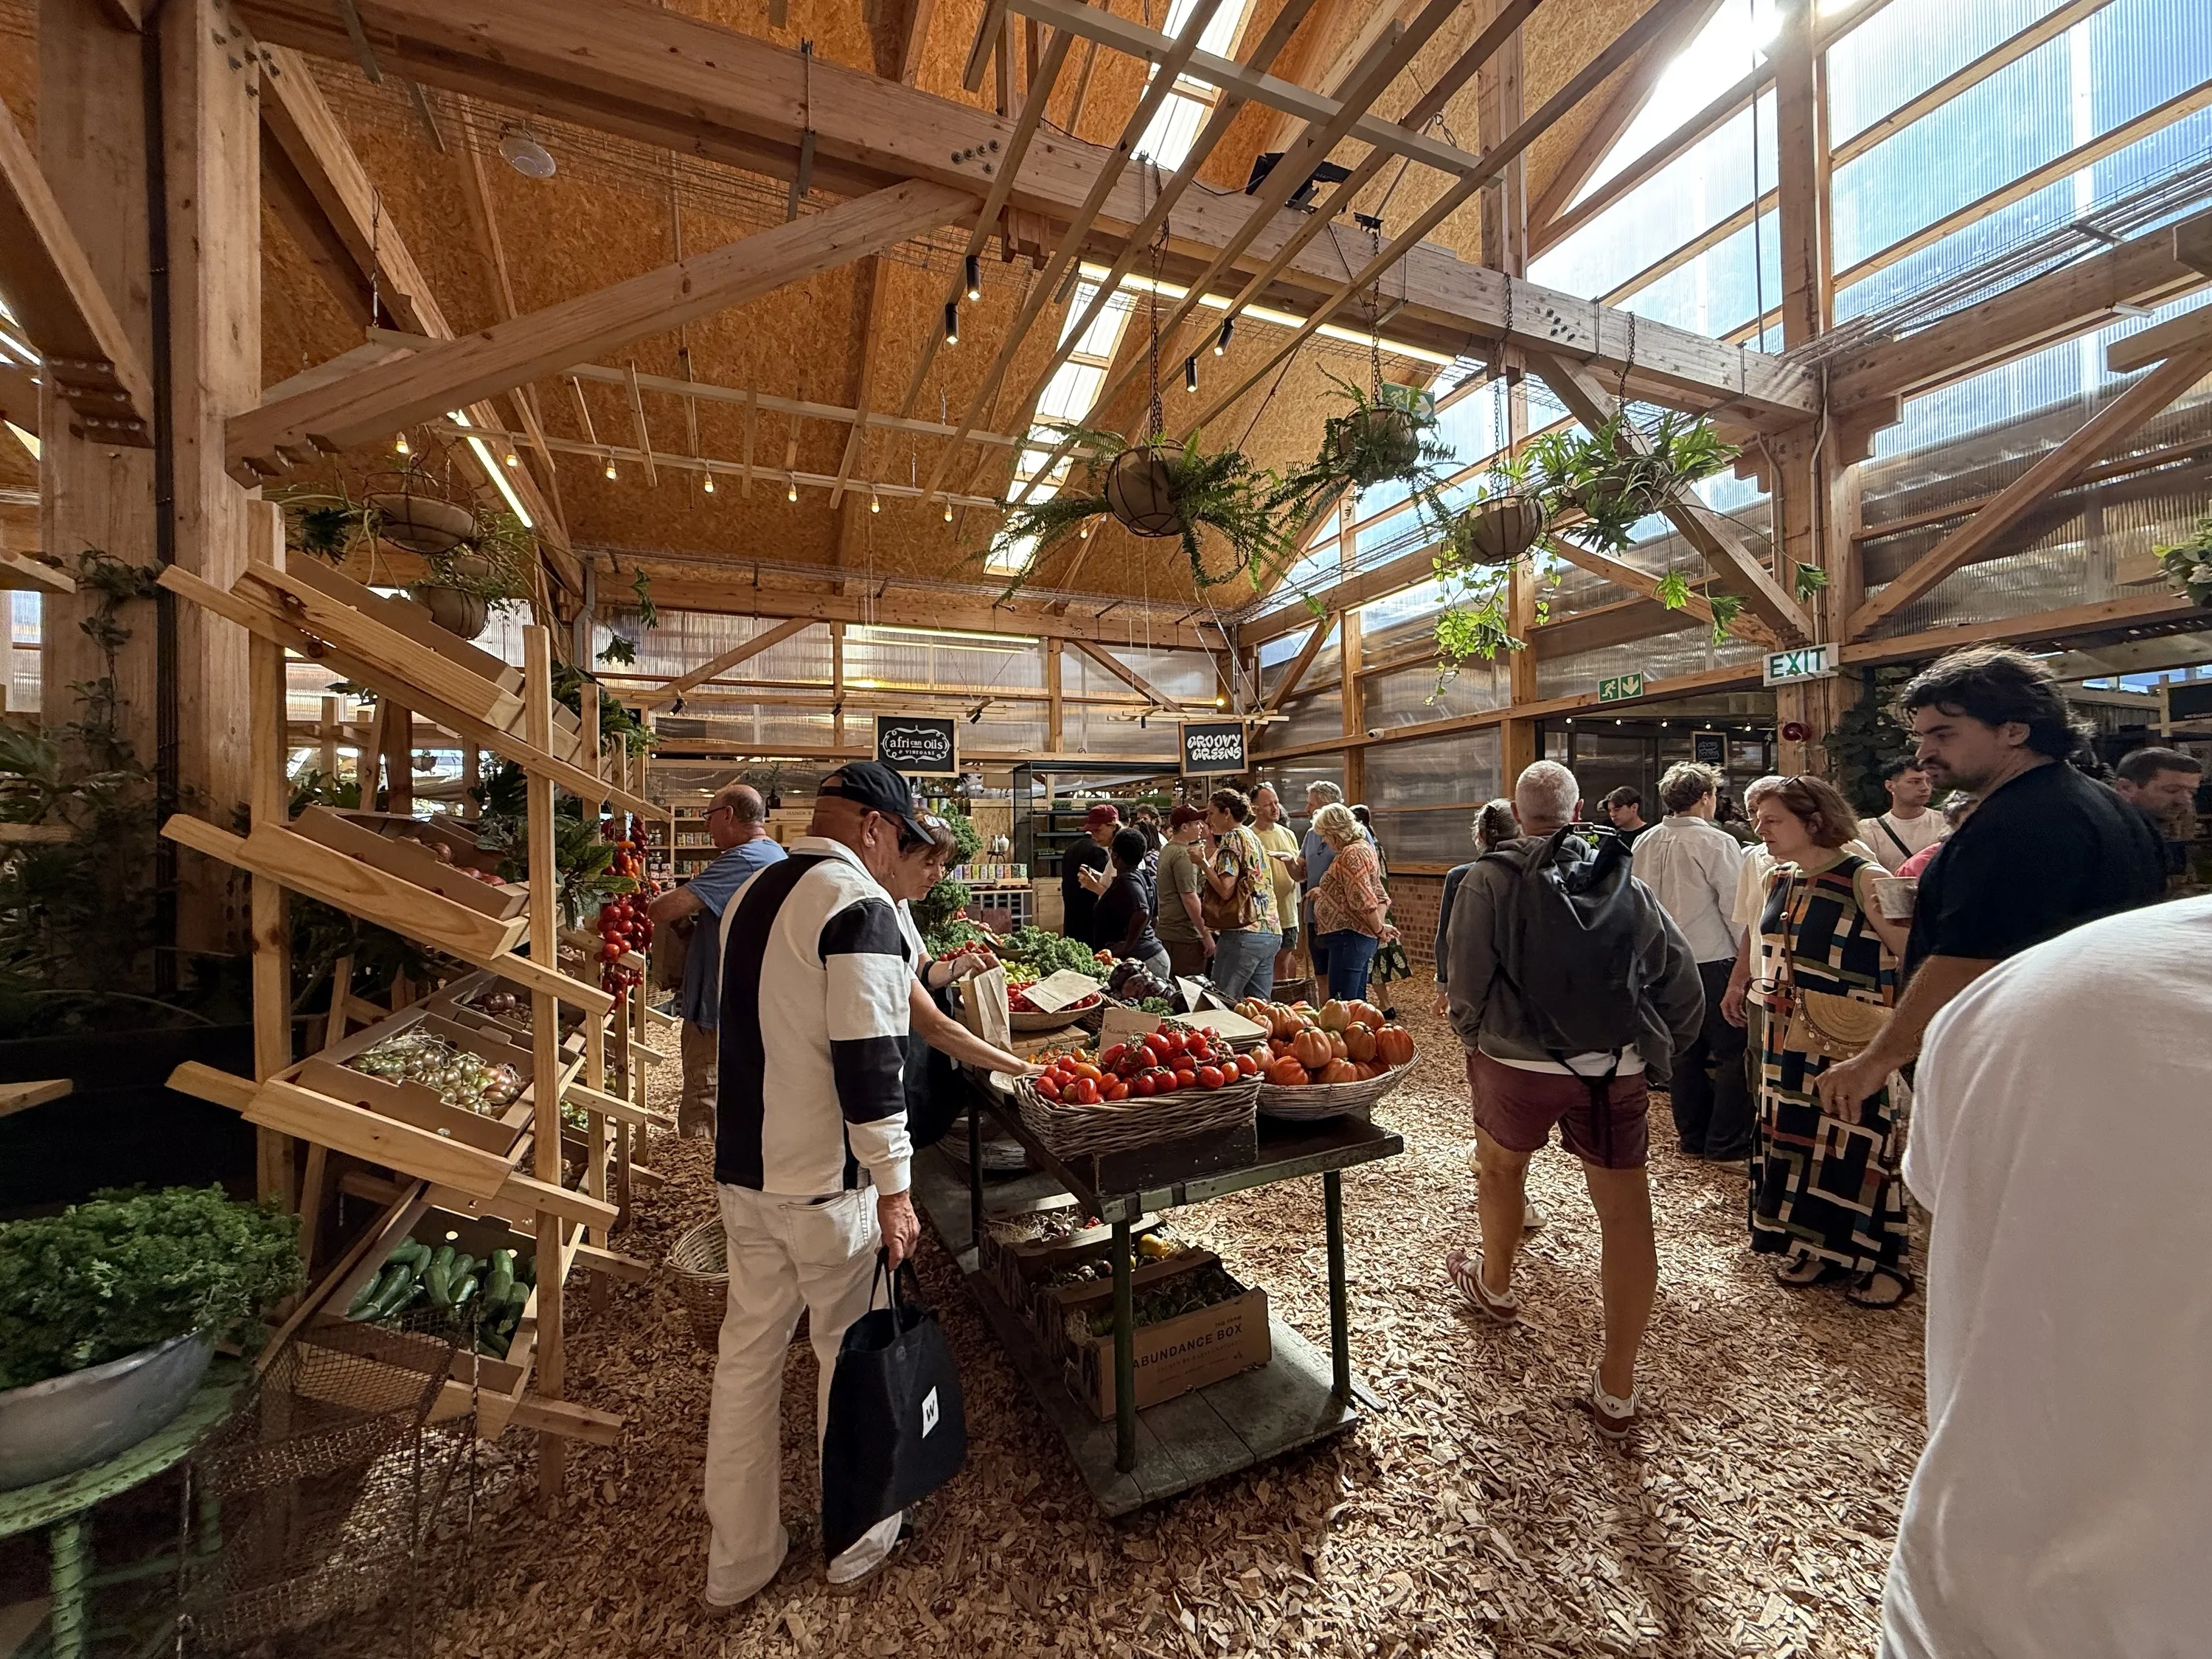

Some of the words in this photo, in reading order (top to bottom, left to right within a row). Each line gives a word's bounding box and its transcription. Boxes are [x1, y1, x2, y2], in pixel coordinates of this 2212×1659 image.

[1770, 646, 1826, 678] EXIT
[1186, 734, 1242, 749] GROOVY
[1191, 746, 1242, 761] GREENS
[1226, 1315, 1242, 1324] FARM
[1133, 1333, 1213, 1370] ABUNDANCE
[1217, 1323, 1242, 1341] BOX
[926, 1399, 935, 1422] W
